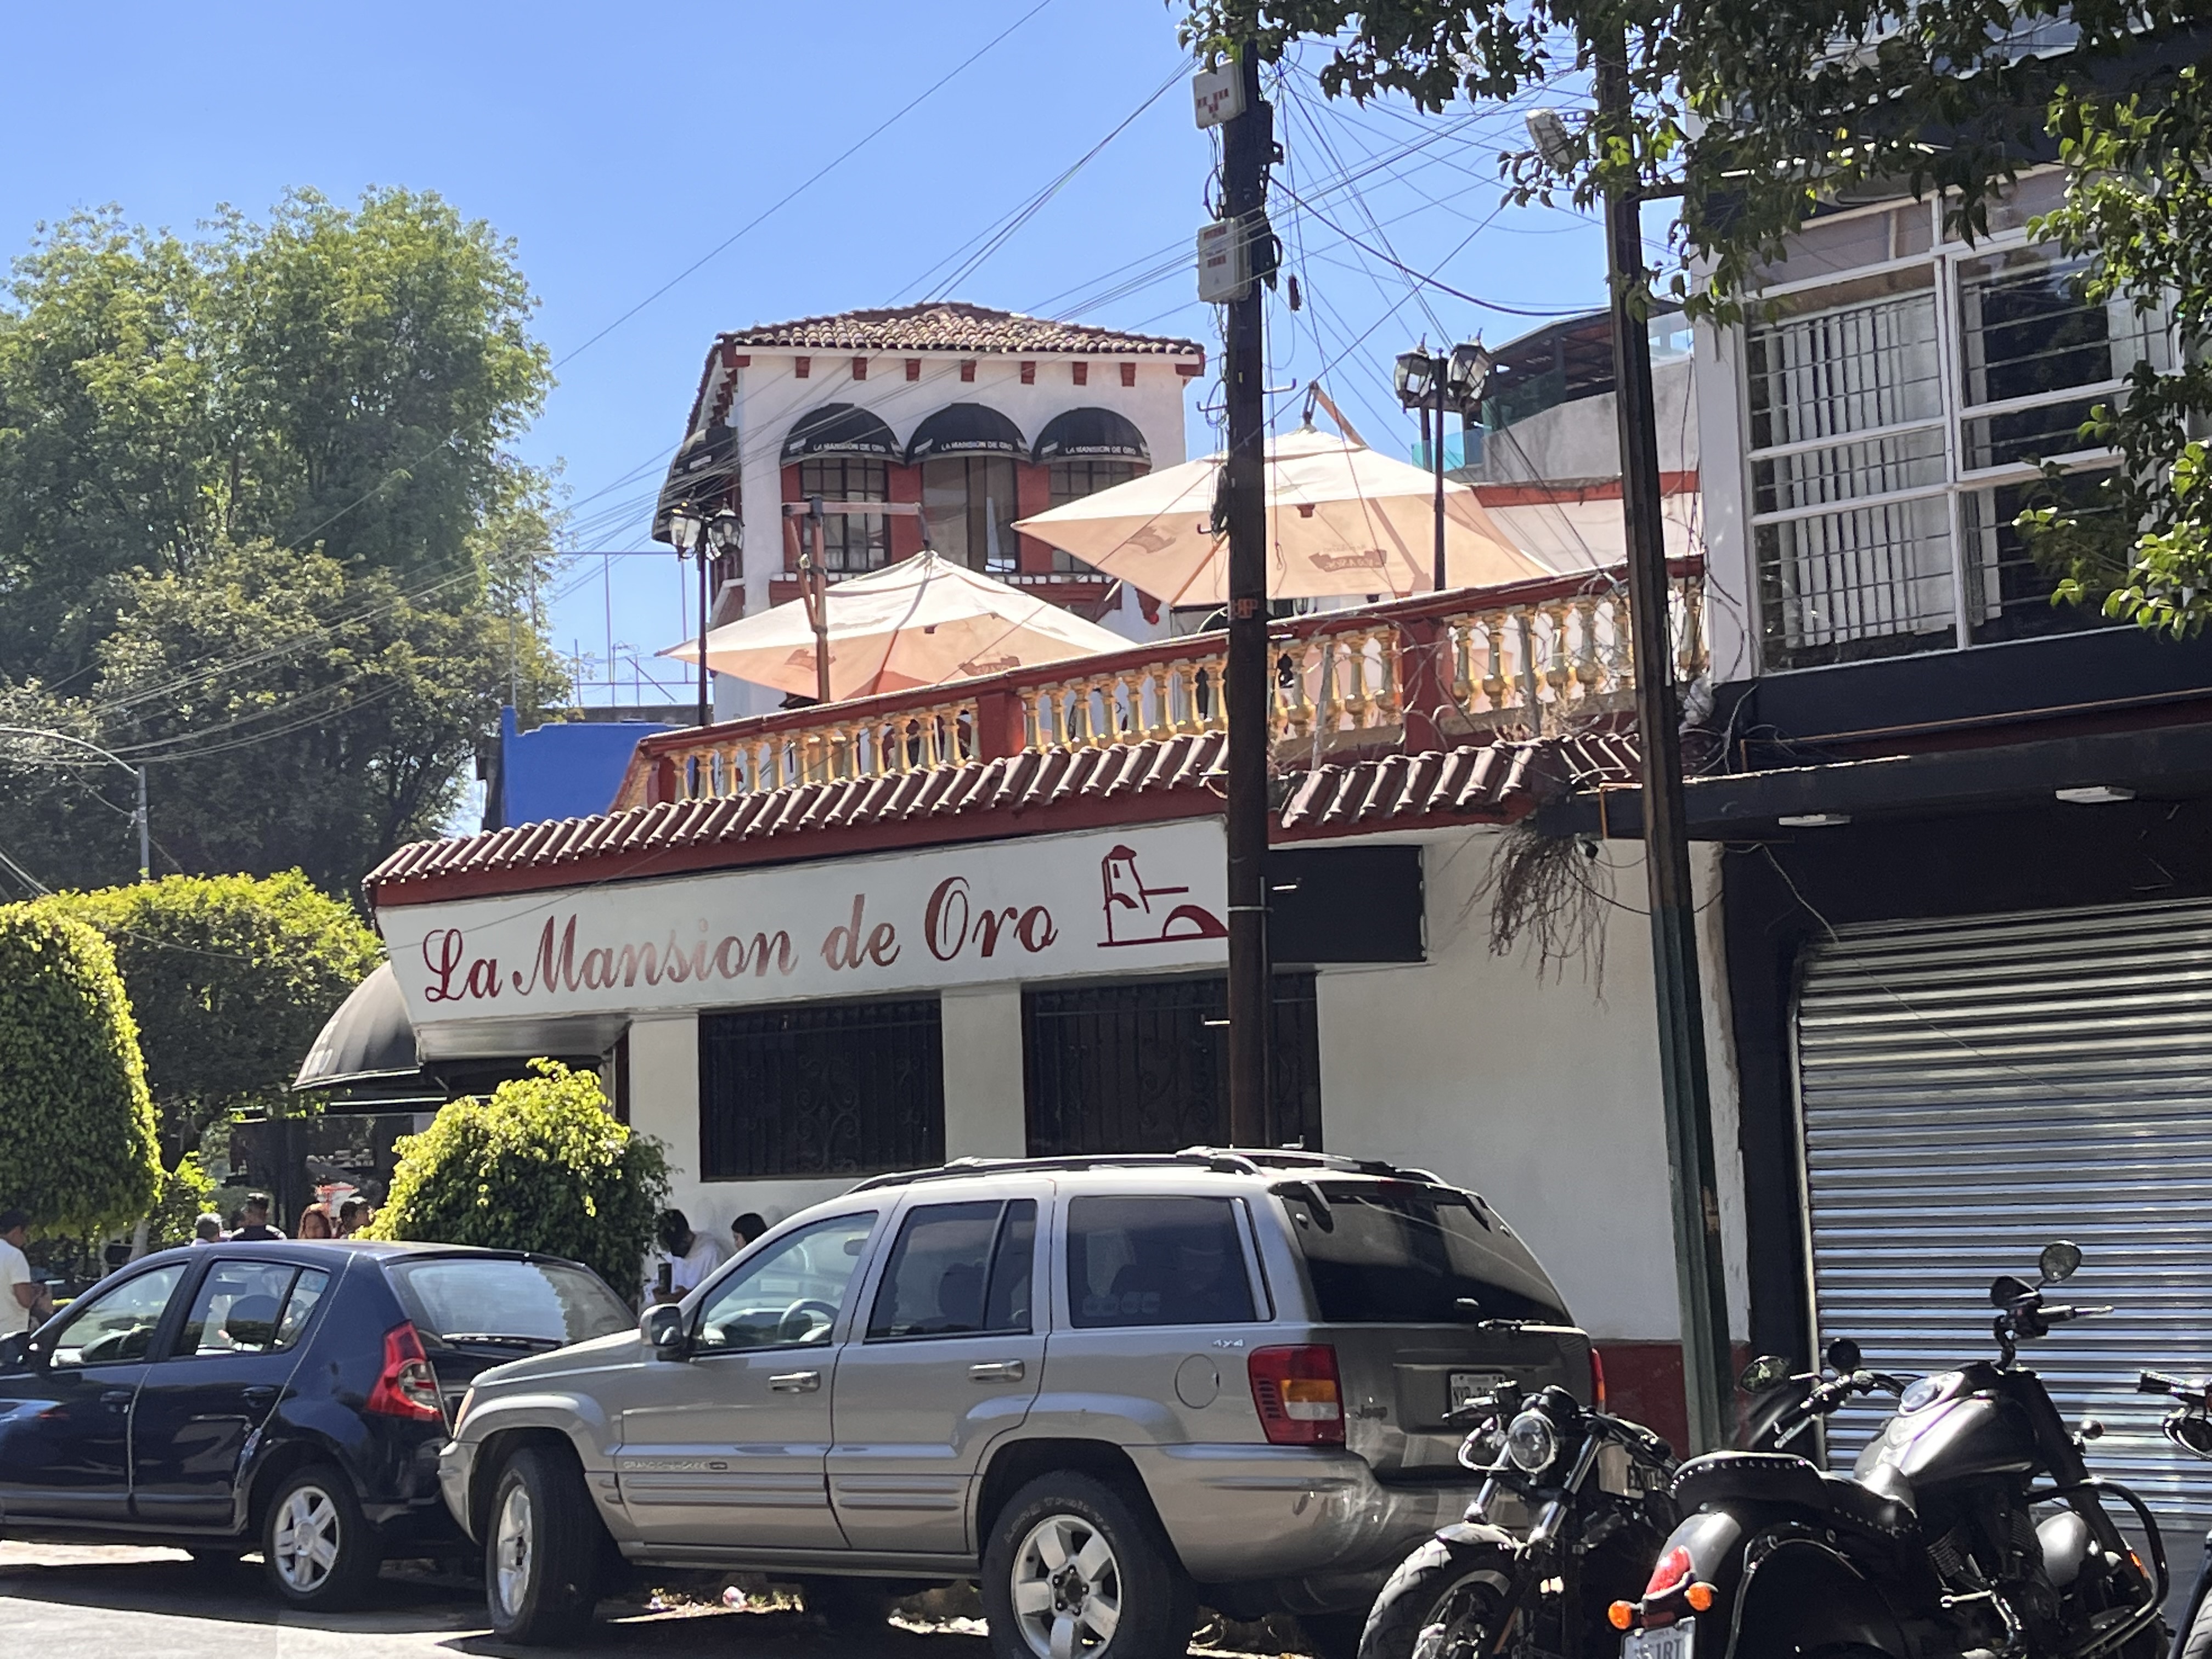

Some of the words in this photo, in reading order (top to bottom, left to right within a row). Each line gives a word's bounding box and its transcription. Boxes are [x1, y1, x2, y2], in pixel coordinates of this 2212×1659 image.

[813, 443, 822, 452] LA
[860, 443, 871, 452] DE
[871, 443, 886, 453] ORO
[941, 442, 951, 451] LA
[988, 441, 998, 449] DE
[998, 442, 1013, 451] ORO
[1111, 445, 1121, 454] DE
[1122, 446, 1136, 455] ORO
[423, 928, 503, 1002] La
[512, 913, 799, 996] Mansion
[820, 893, 901, 972] de
[924, 876, 1059, 961] Oro
